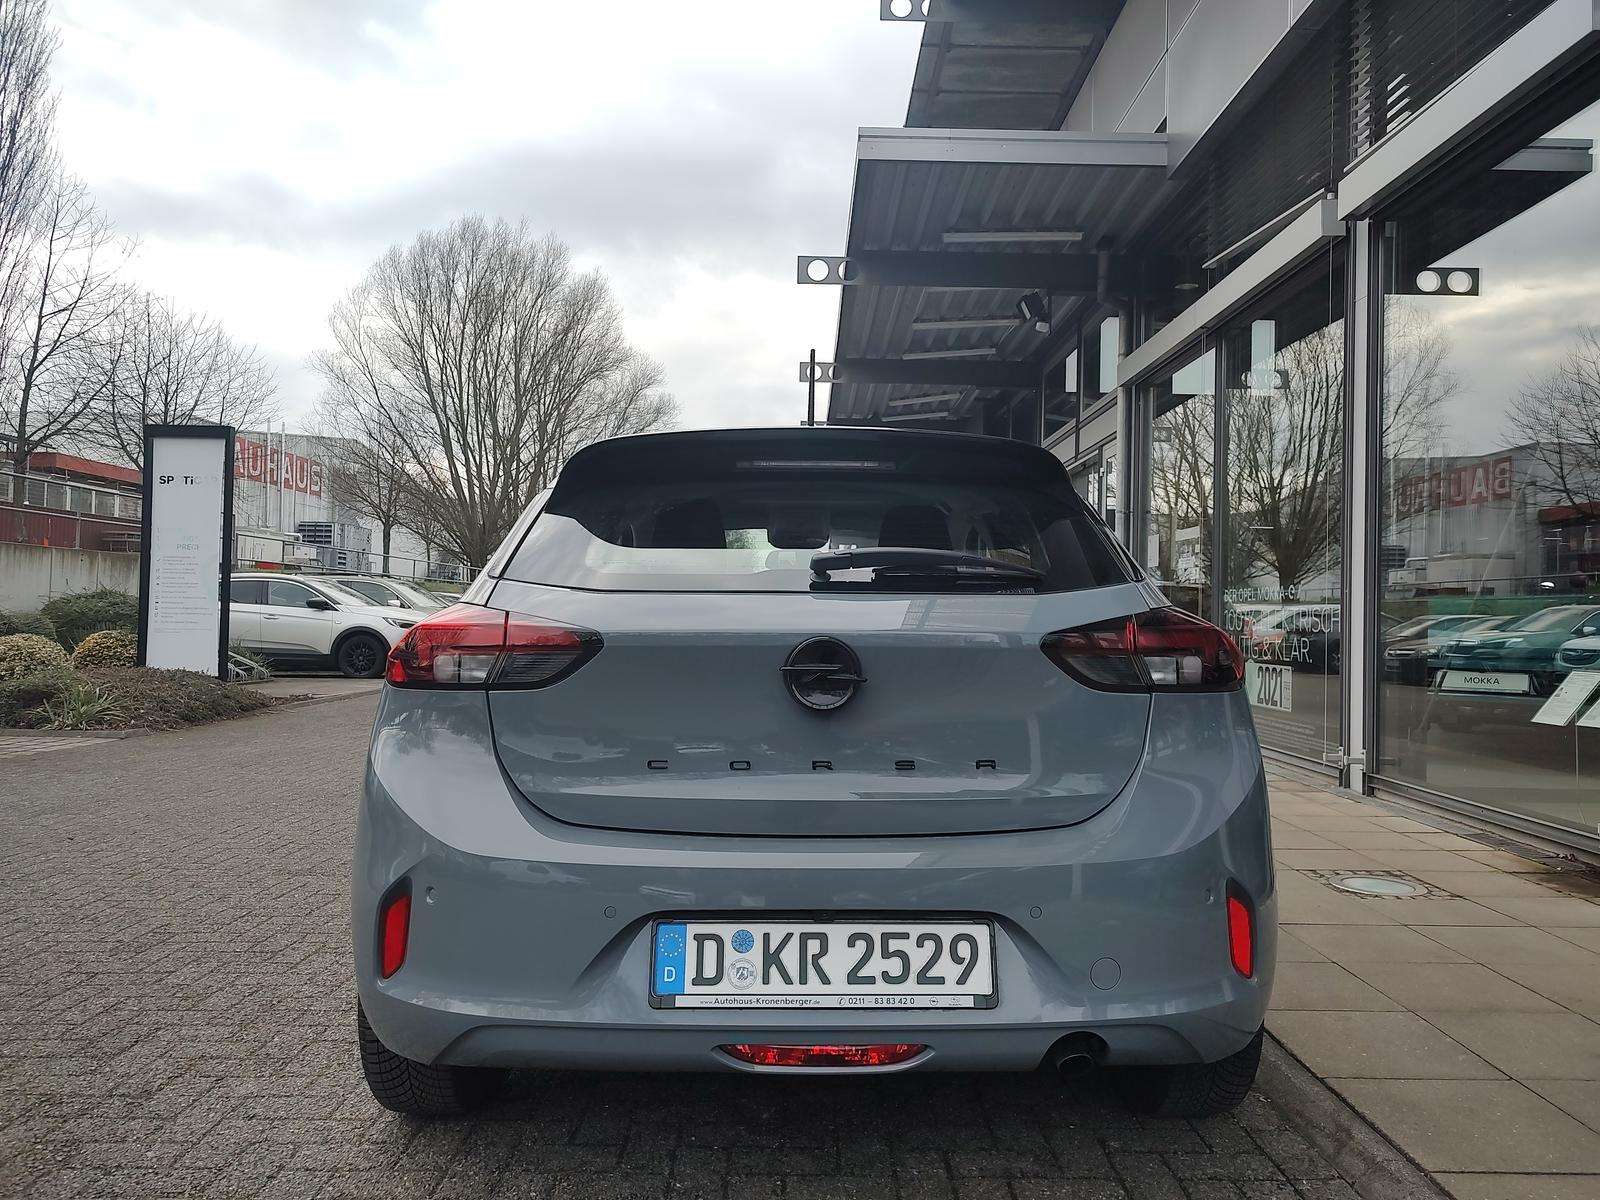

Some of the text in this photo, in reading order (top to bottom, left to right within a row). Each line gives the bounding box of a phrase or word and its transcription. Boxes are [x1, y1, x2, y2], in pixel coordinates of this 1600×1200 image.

[235, 440, 321, 493] AUHAUS
[1239, 587, 1256, 602] OPEL
[1262, 636, 1272, 660] &
[1257, 666, 1283, 708] 2021
[1464, 675, 1501, 686] MOKKA
[647, 759, 997, 771] CORSA
[692, 933, 725, 986] D
[762, 932, 831, 985] KR
[846, 932, 979, 985] 2529
[664, 966, 676, 982] D
[848, 997, 865, 1006] 0211
